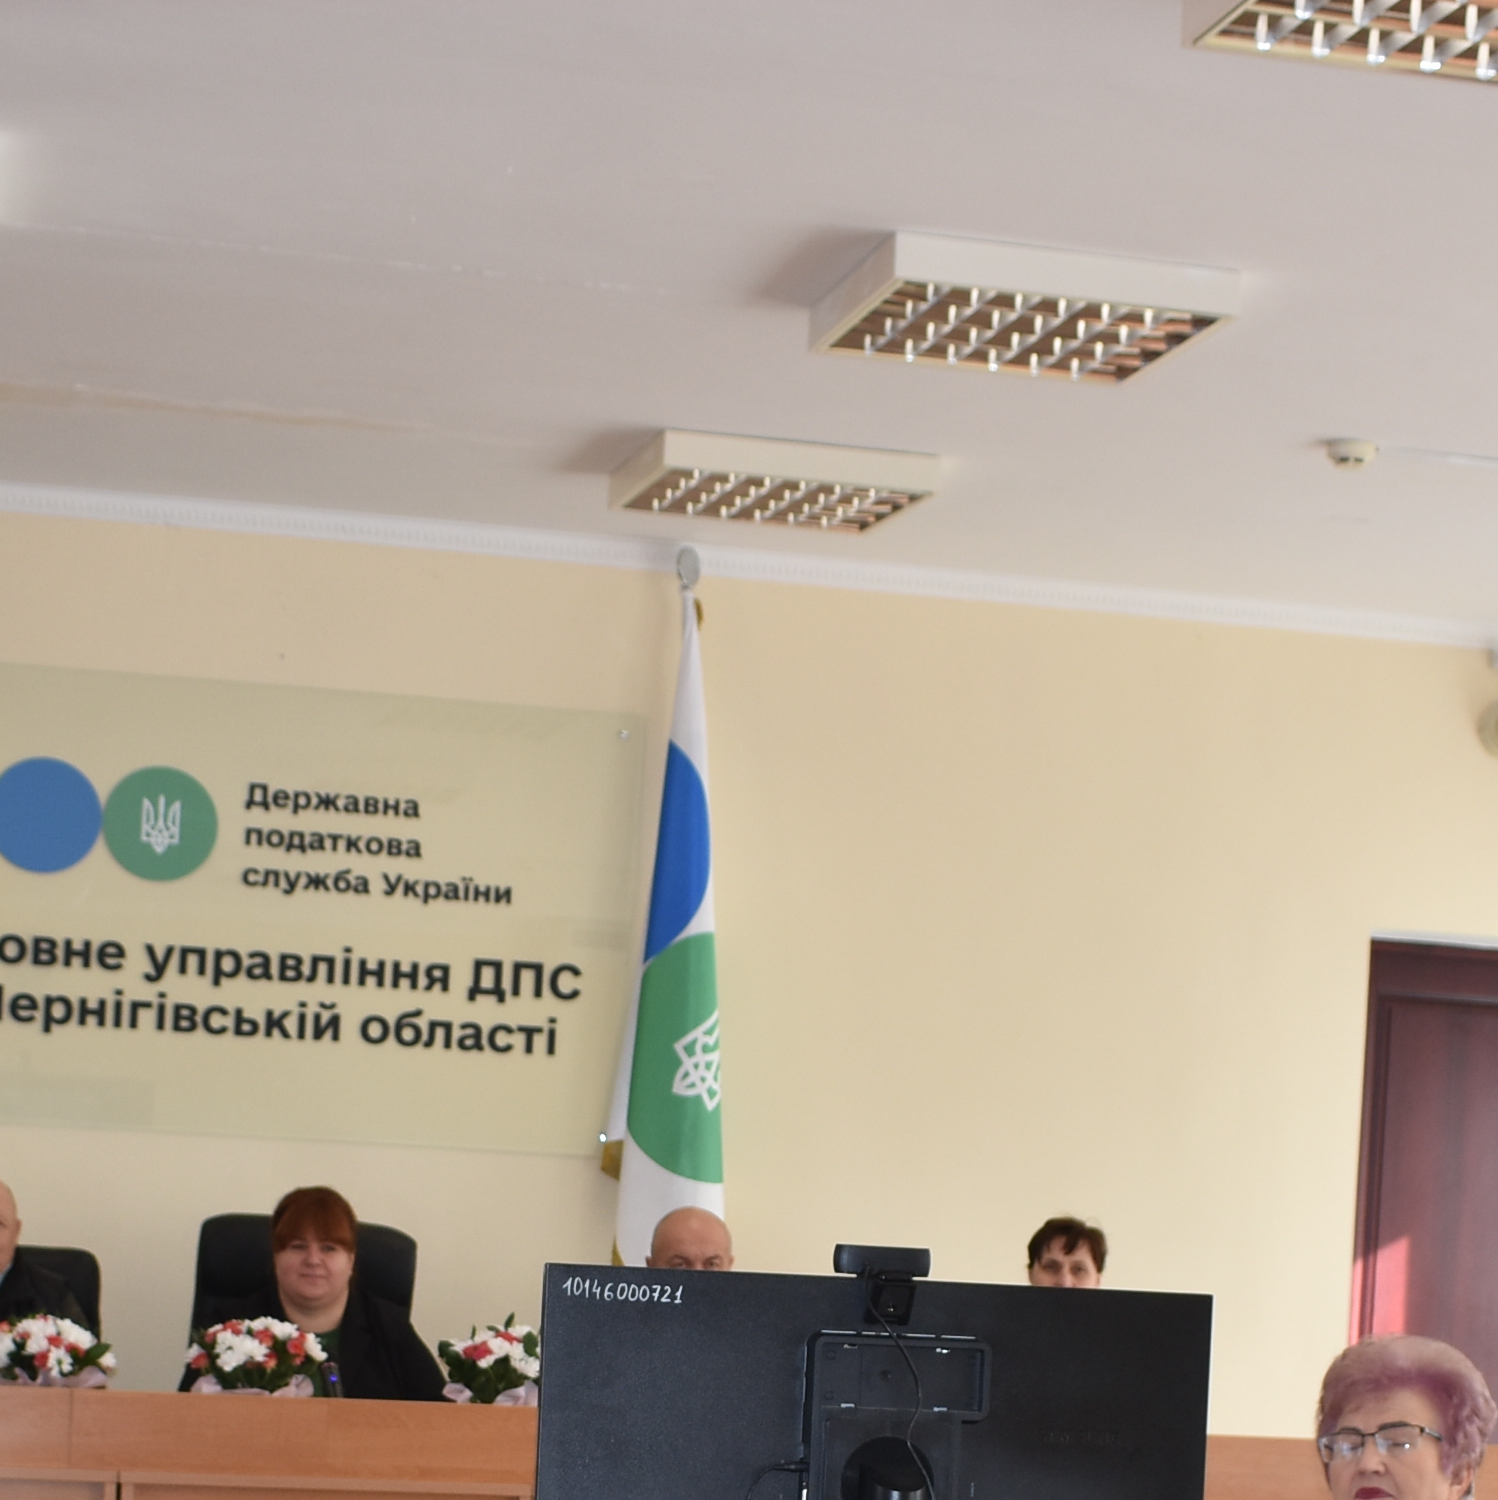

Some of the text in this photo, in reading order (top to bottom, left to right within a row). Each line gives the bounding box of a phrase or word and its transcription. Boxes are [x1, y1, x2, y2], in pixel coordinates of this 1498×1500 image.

[244, 782, 421, 818] Державна
[243, 827, 423, 858] податкова
[241, 867, 513, 906] служба України
[142, 943, 451, 993] управління
[467, 957, 583, 1004] ДПС
[359, 1010, 557, 1056] області
[561, 1275, 685, 1305] 10146000721
